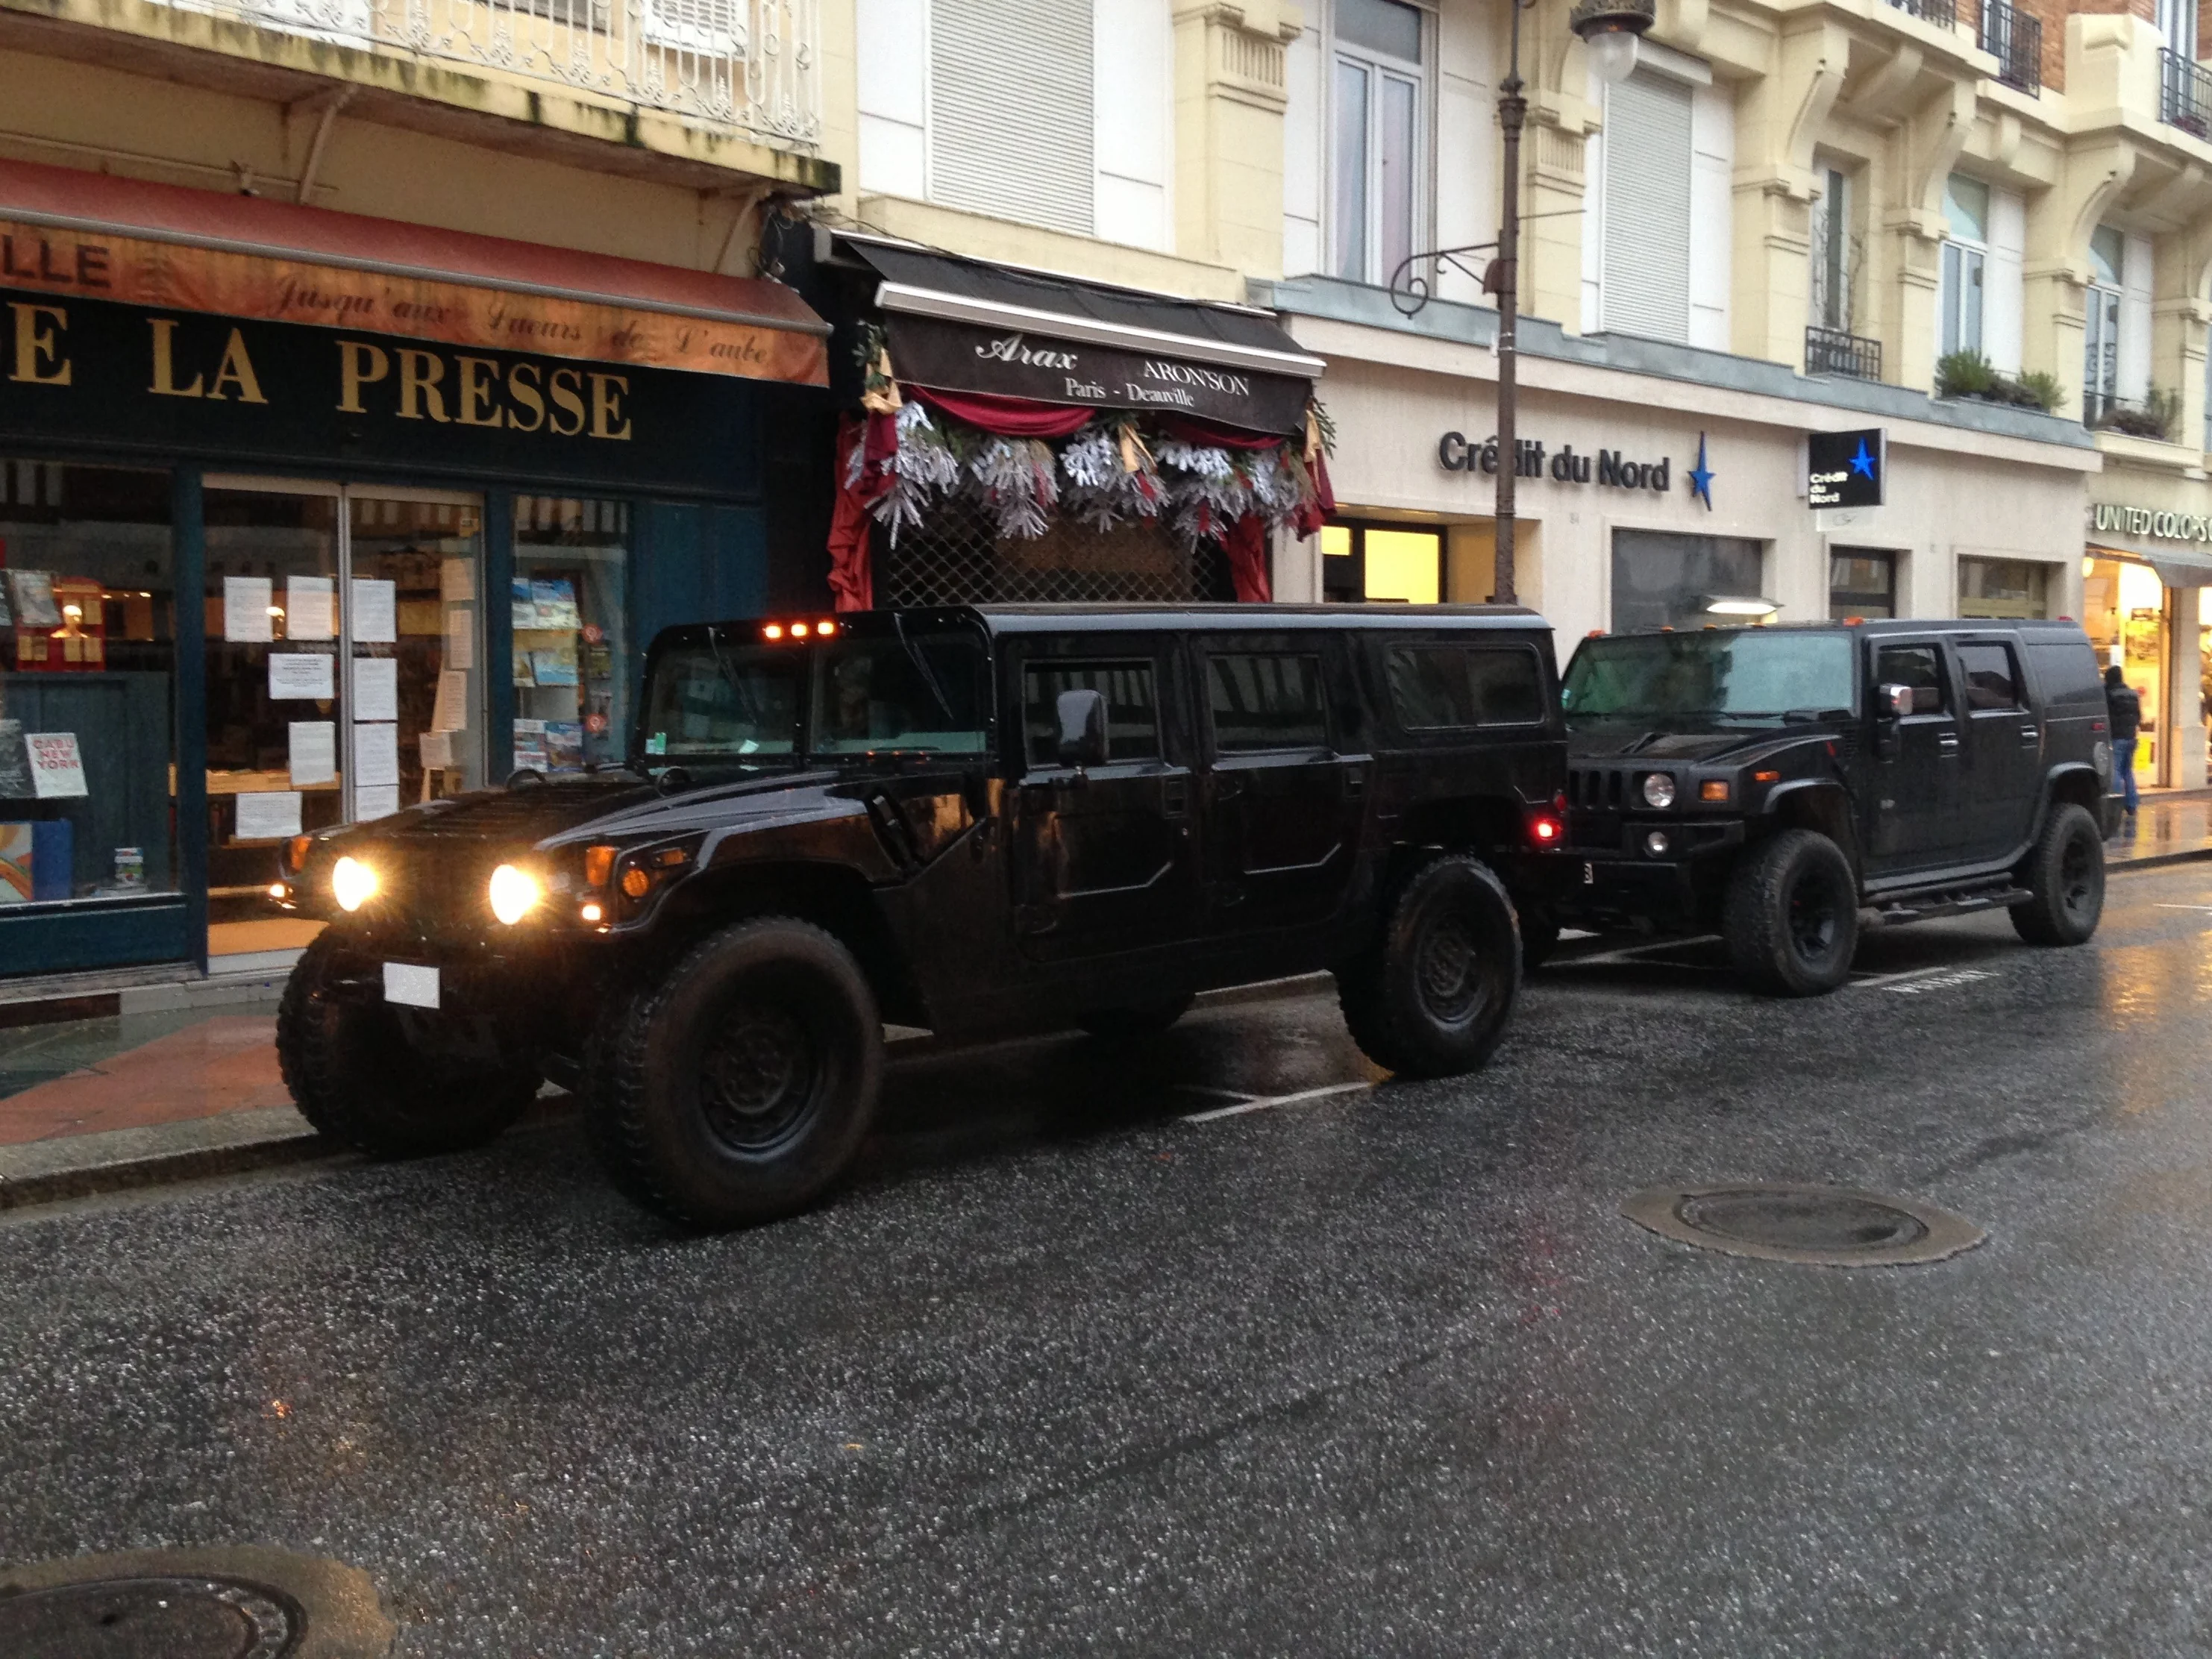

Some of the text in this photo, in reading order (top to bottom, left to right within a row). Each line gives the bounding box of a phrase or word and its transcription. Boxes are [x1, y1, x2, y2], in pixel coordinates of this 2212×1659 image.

[9, 302, 631, 441] E LA PRESSE
[974, 333, 1250, 397] Arax ARONSON
[1065, 377, 1107, 398] Paris
[1126, 382, 1195, 407] Deauville
[1552, 445, 1591, 483] du
[1599, 449, 1670, 491] Nord
[1809, 492, 1840, 504] Nord
[2096, 504, 2152, 535] UNITED
[37, 759, 79, 770] YORK
[40, 750, 72, 759] NEW
